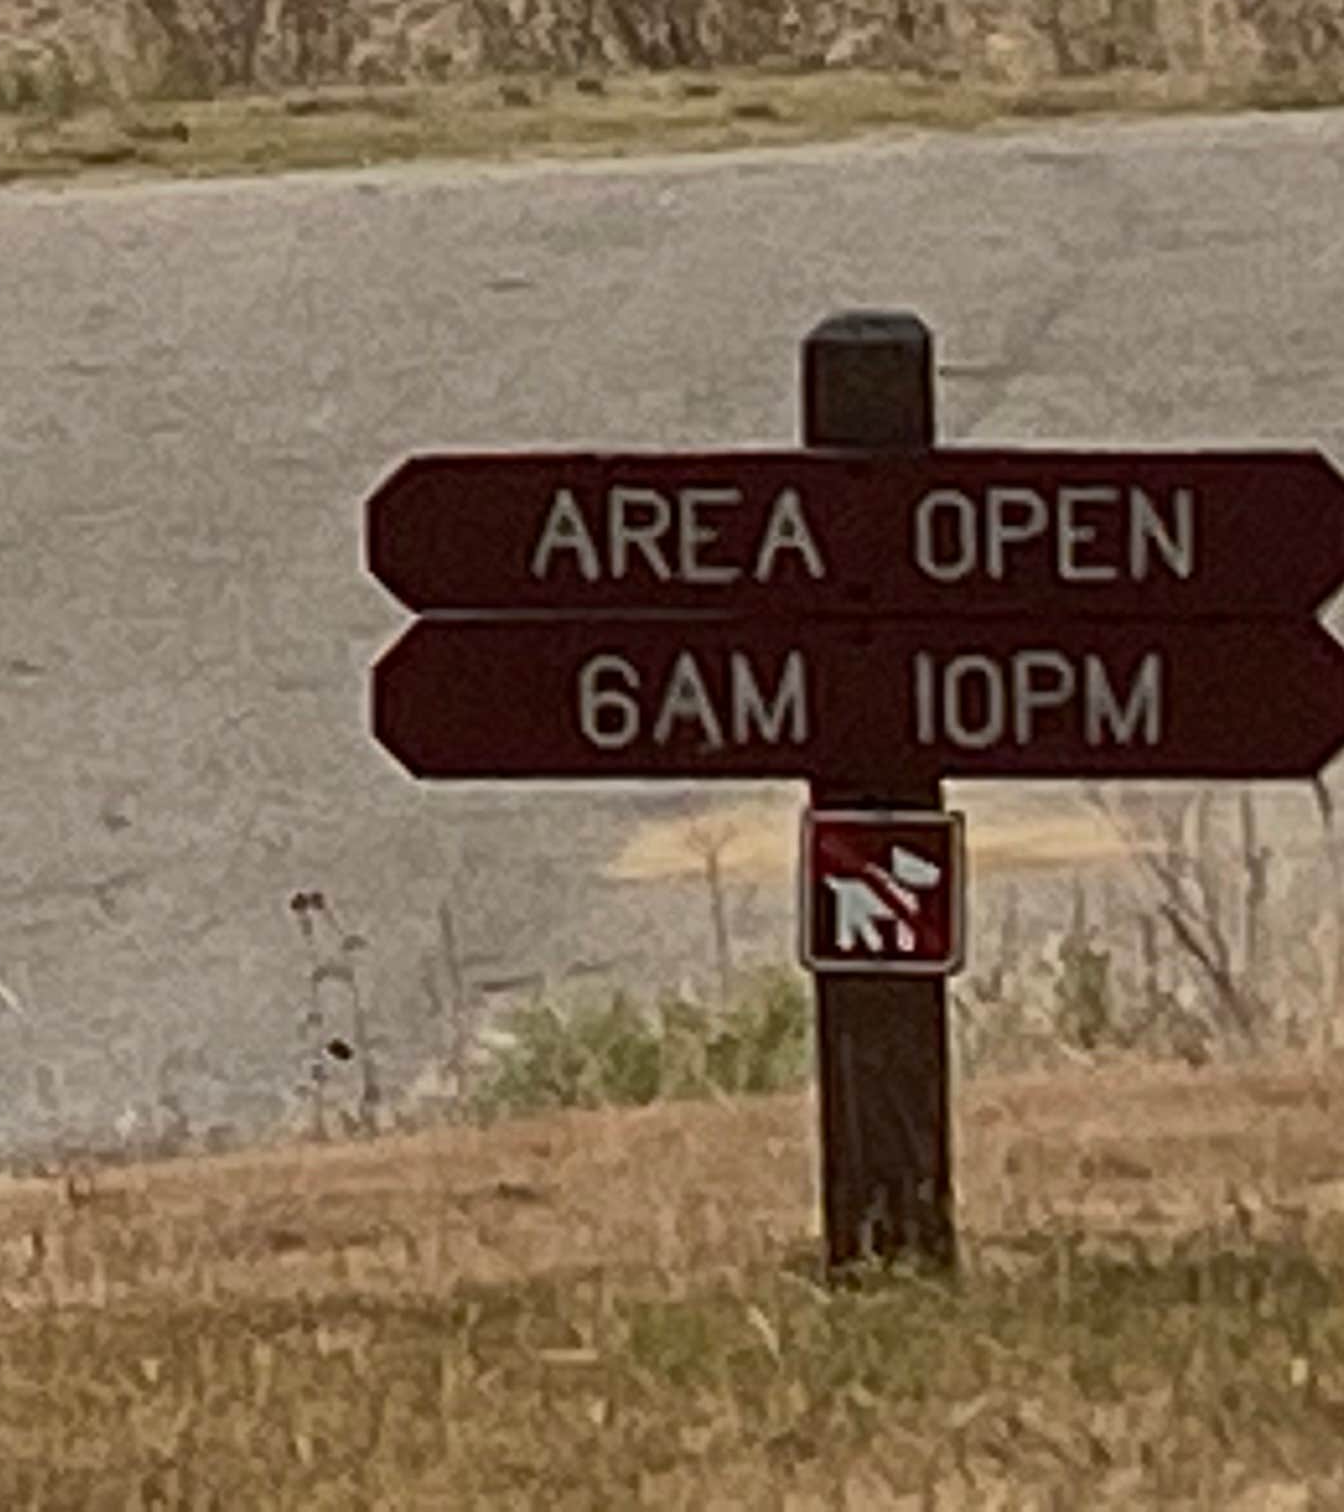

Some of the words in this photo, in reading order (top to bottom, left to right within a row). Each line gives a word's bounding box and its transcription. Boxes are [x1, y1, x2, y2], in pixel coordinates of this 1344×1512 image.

[532, 487, 823, 580] AREA
[916, 486, 1194, 581] OPEN
[579, 652, 807, 747] 6AM
[916, 652, 1161, 746] 10PM
